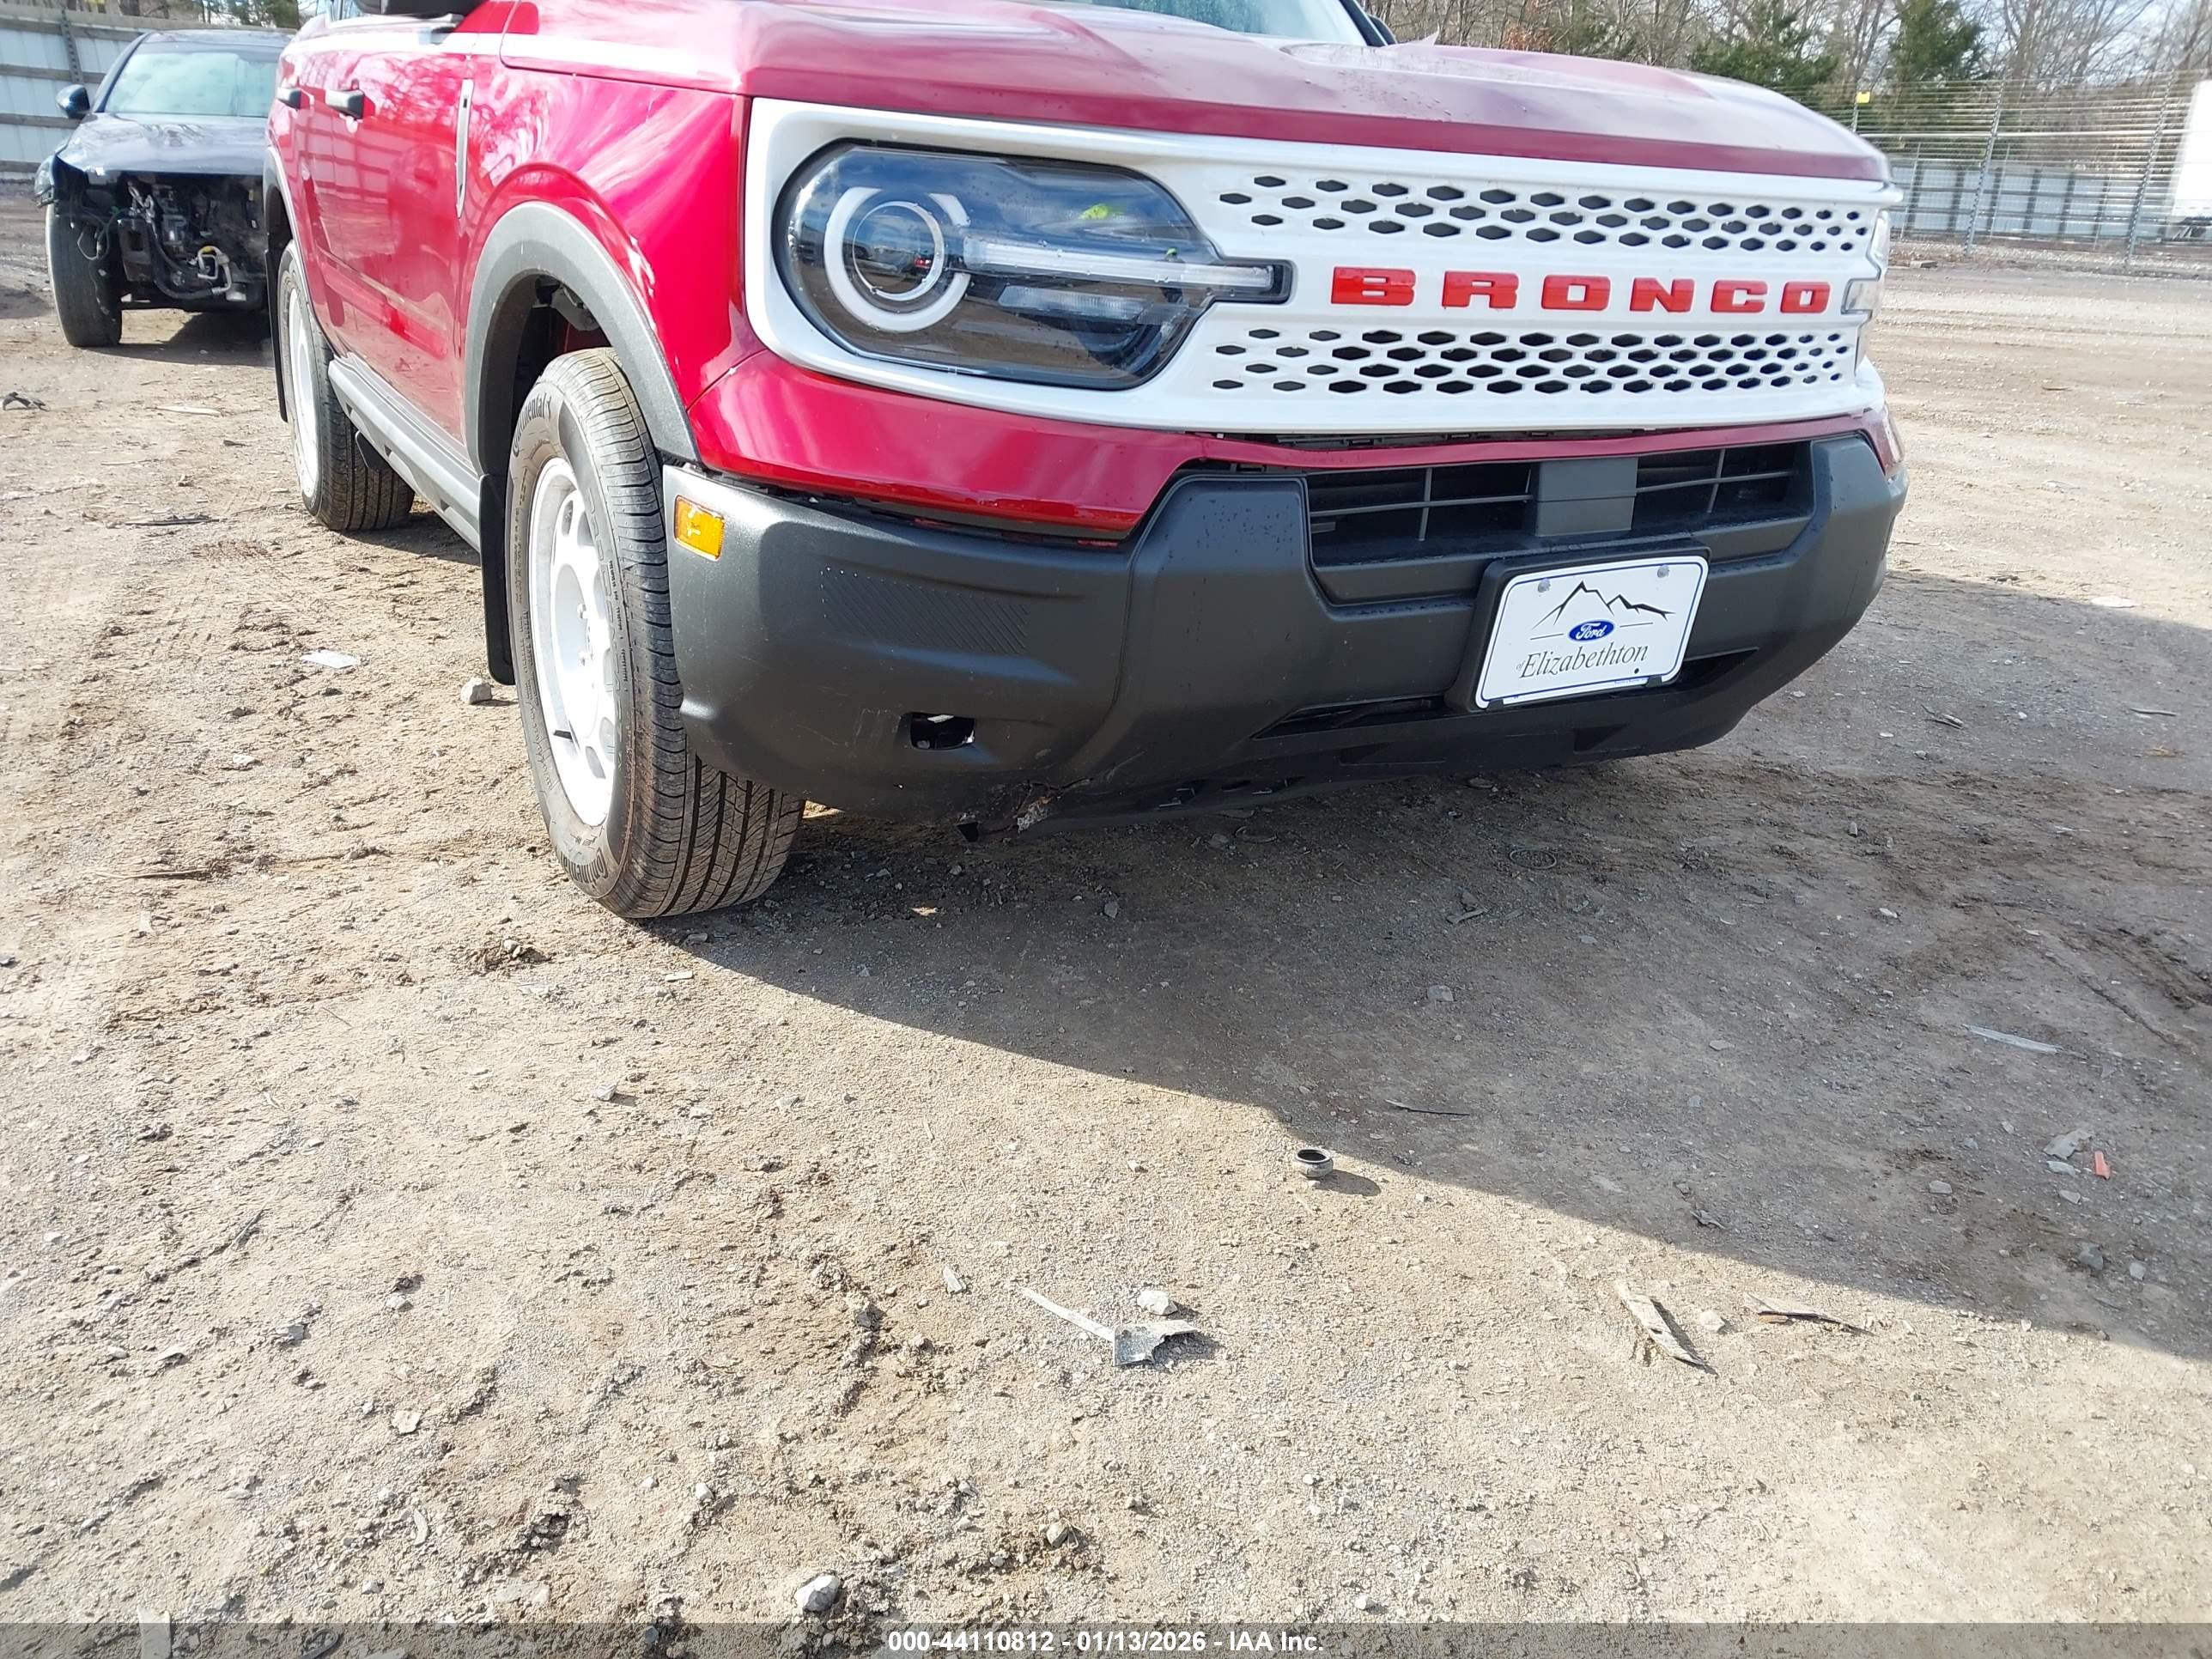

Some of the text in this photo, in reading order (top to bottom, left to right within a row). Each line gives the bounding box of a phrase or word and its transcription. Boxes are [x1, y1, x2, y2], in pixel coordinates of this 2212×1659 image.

[1331, 266, 1831, 313] BRONCO
[1575, 621, 1608, 640] Ford
[1519, 642, 1649, 678] Elizabethton
